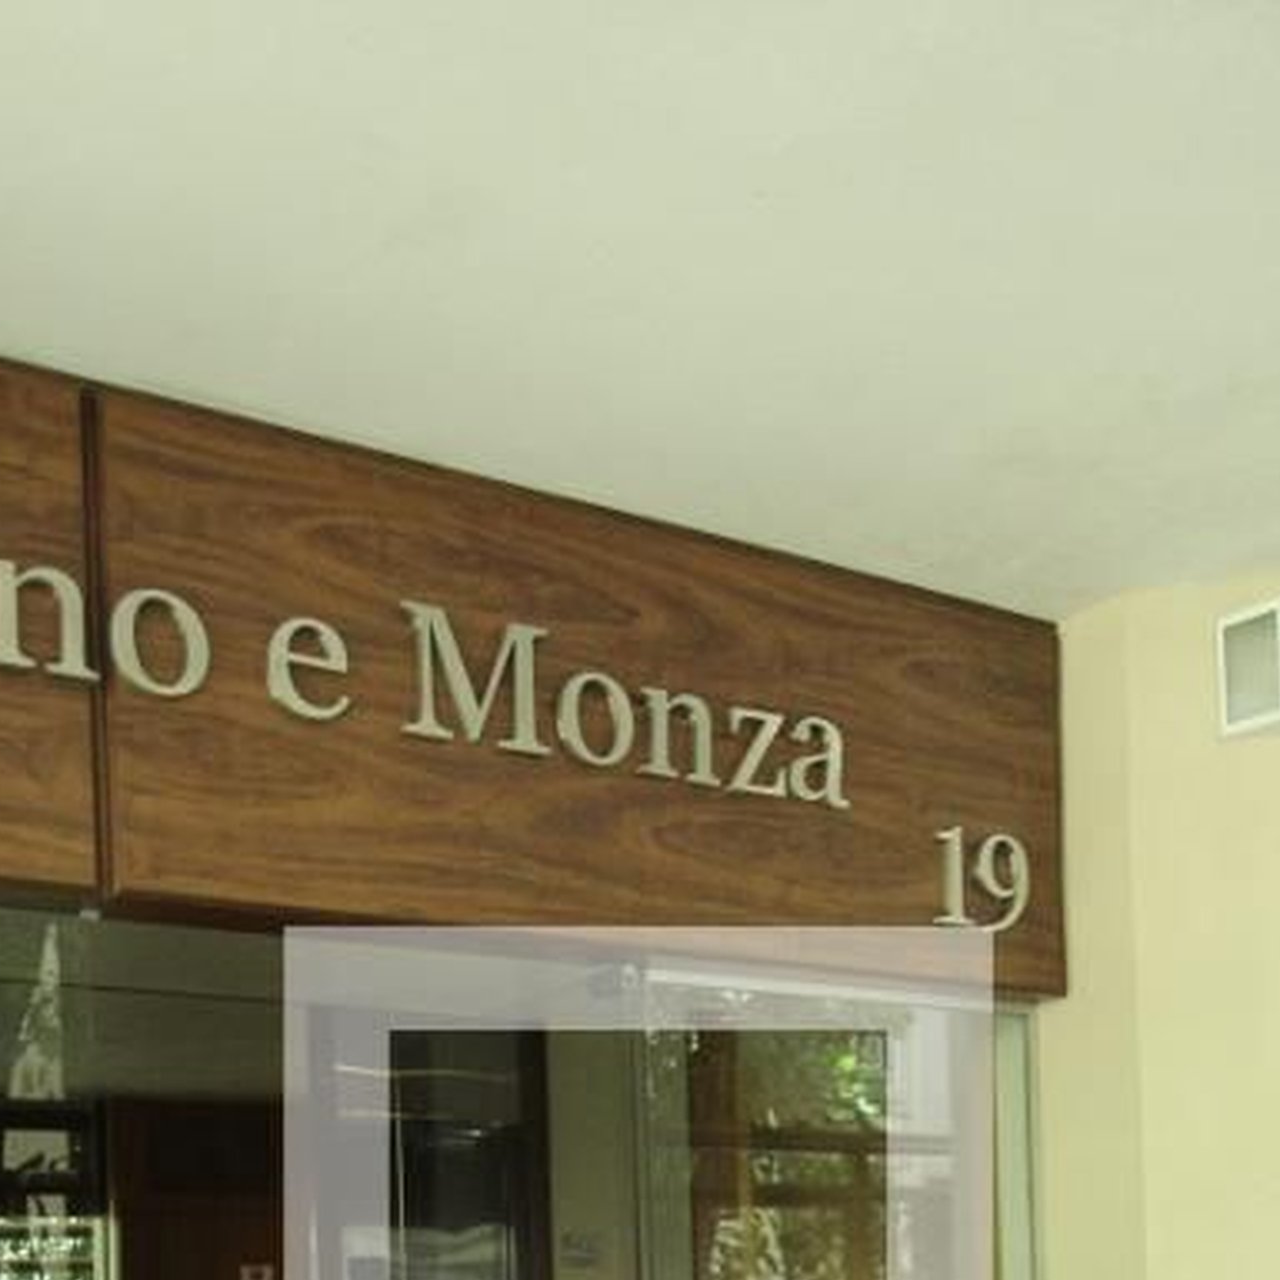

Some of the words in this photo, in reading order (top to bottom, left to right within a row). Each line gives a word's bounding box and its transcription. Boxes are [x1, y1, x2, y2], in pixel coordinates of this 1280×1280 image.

[266, 615, 351, 720] e
[400, 600, 851, 808] Monza
[932, 825, 1031, 933] 19
